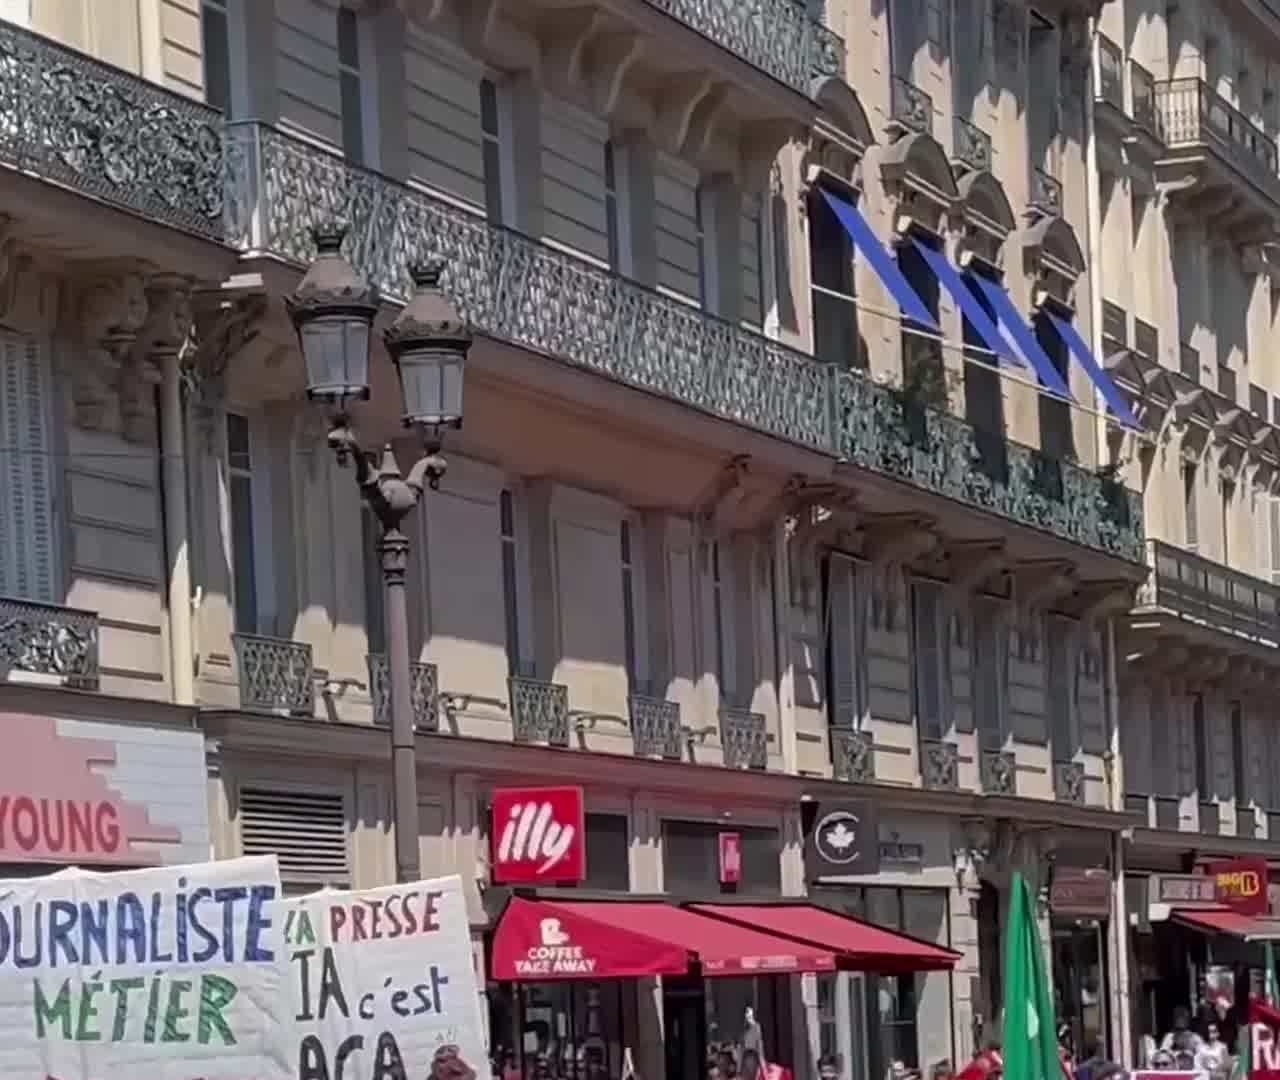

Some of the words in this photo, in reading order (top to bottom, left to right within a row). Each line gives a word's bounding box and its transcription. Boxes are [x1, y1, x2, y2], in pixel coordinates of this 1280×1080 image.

[499, 801, 575, 874] illy
[330, 891, 443, 943] PRESSE
[513, 959, 550, 976] TAKE
[552, 957, 597, 974] AWAY
[527, 945, 583, 960] COFFEE
[32, 970, 239, 1047] MÉTIER
